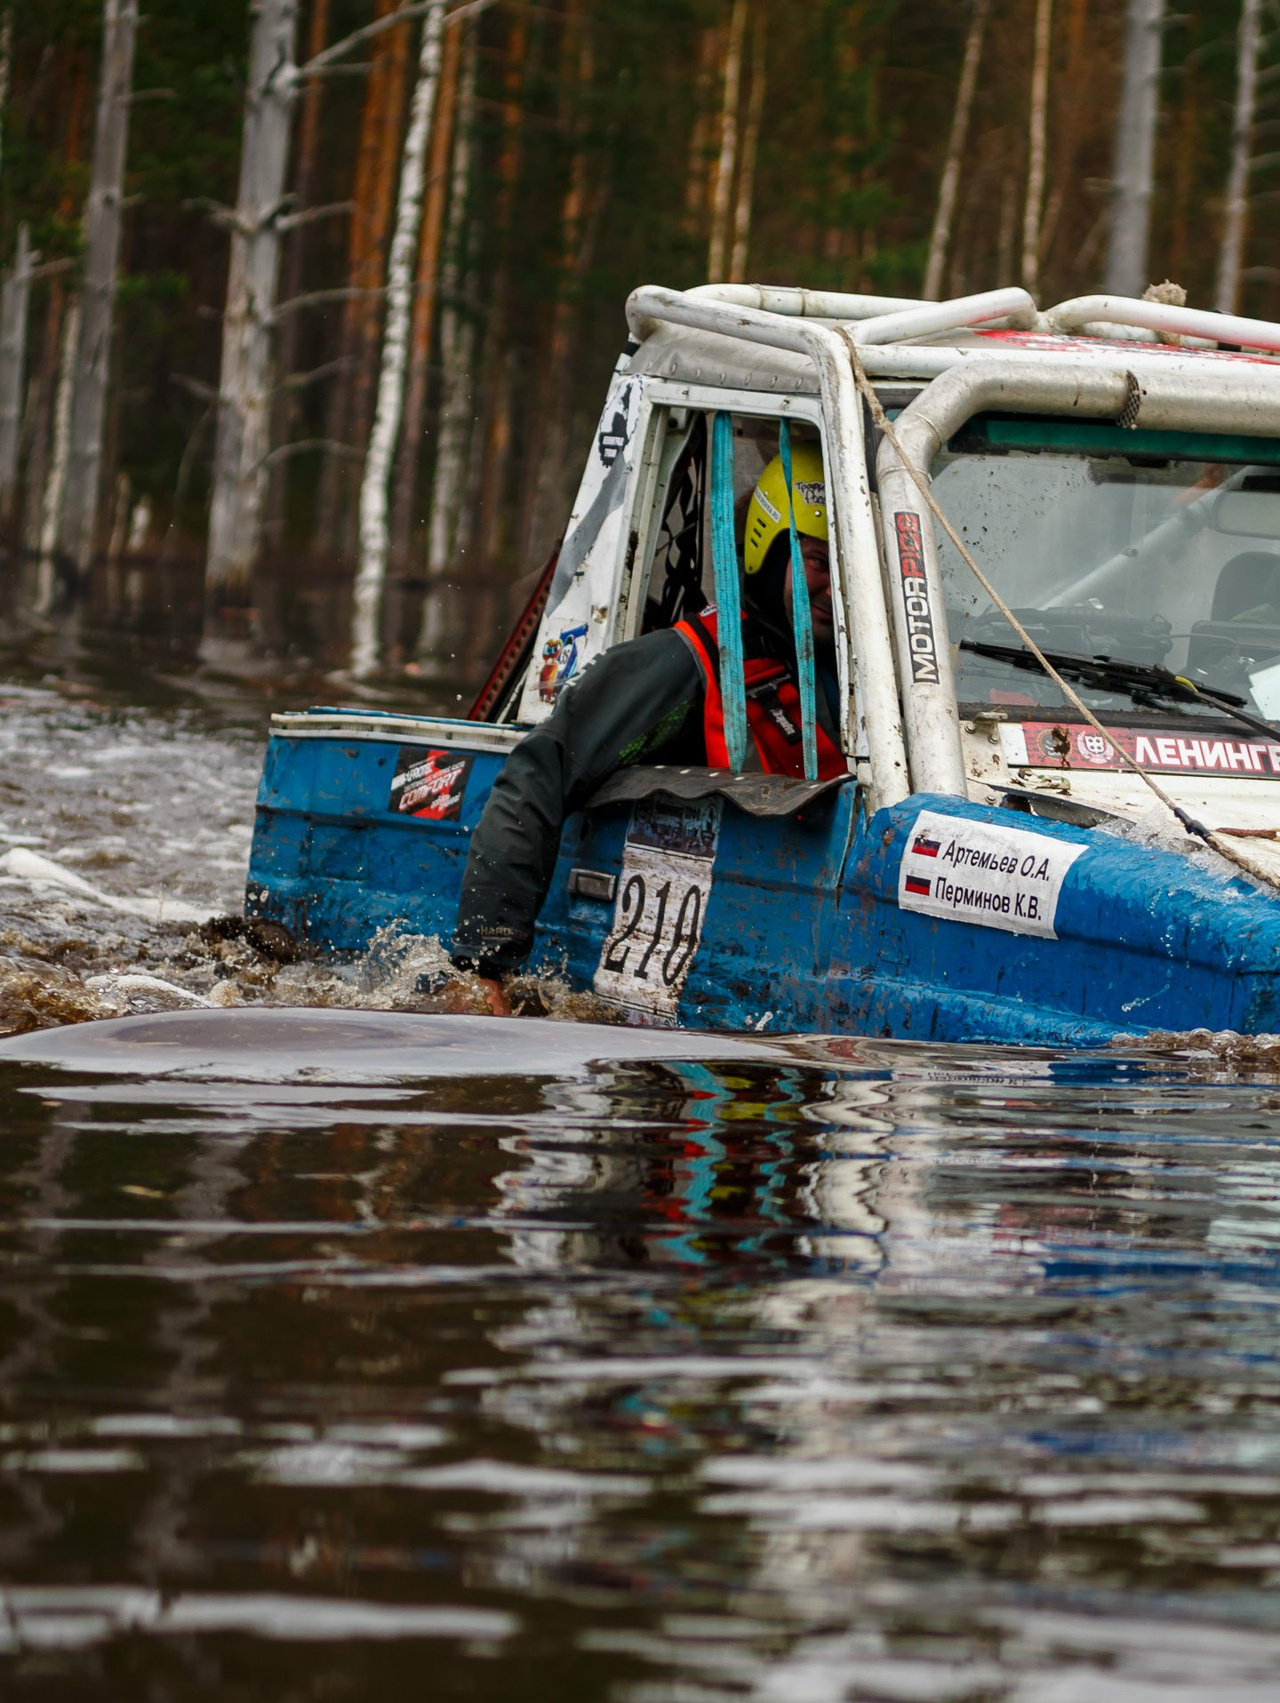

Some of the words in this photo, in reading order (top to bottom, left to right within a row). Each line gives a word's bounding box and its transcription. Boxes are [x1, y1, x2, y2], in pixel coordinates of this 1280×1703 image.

[942, 840, 1018, 875] Артемьев
[1020, 855, 1050, 882] О.А.
[935, 877, 1011, 914] Перминов
[1014, 896, 1042, 921] К.В.
[603, 873, 700, 986] 210
